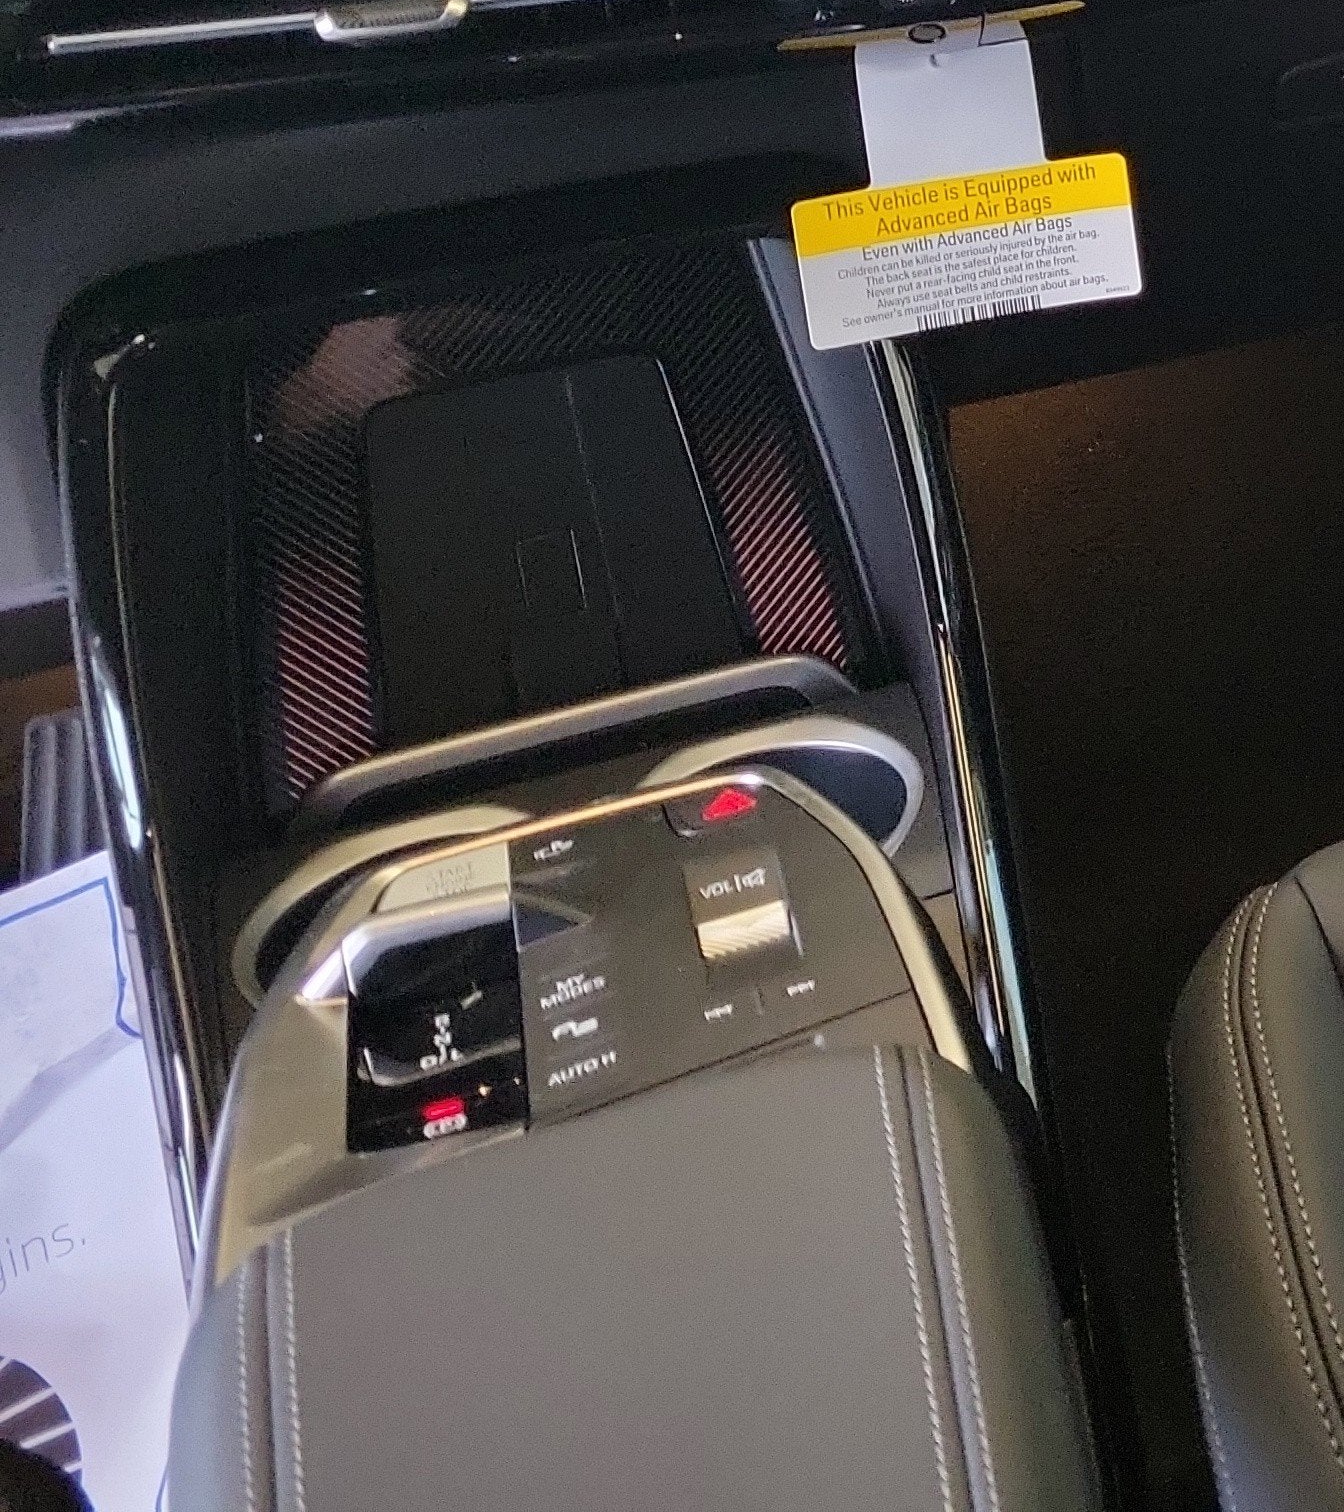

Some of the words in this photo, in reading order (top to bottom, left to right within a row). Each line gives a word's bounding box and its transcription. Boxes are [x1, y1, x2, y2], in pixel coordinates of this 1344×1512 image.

[822, 200, 864, 221] This
[868, 186, 939, 212] Vehicle
[944, 183, 959, 201] is
[964, 168, 1053, 200] Equipped
[1057, 163, 1096, 183] with
[877, 204, 969, 236] Advanced
[975, 200, 1000, 225] Air
[1005, 195, 1052, 216] Bags
[838, 265, 880, 280] Children
[881, 262, 900, 272] can
[901, 257, 915, 268] be
[915, 252, 941, 266] killed
[943, 251, 954, 261] or
[955, 243, 999, 259] seriously
[1000, 238, 1032, 252] injured
[1034, 235, 1046, 248] by
[1047, 233, 1063, 244] the
[1065, 231, 1078, 241] air
[1079, 229, 1100, 240] bag.
[862, 244, 899, 262] Even
[902, 237, 933, 255] with
[937, 222, 1009, 248] Advanced
[1012, 219, 1032, 236] Air
[1035, 216, 1072, 233] Bags
[866, 275, 885, 287] The
[886, 270, 910, 283] back
[911, 267, 932, 278] seat
[934, 264, 942, 275] is
[944, 261, 960, 272] the
[962, 256, 991, 269] safest
[993, 251, 1019, 266] place
[1021, 248, 1035, 259] for
[1036, 244, 1076, 257] children.
[866, 286, 895, 299] Never
[897, 282, 913, 294] put
[915, 280, 922, 289] a
[923, 272, 977, 288] rear-facing
[978, 265, 1003, 278] child
[1004, 262, 1023, 273] seat
[1025, 260, 1034, 270] in
[1036, 258, 1051, 268] the
[1053, 254, 1079, 266] front.
[842, 317, 862, 328] See
[864, 308, 902, 323] owner's
[904, 301, 940, 316] manual
[941, 299, 955, 309] for
[957, 293, 982, 306] more
[984, 283, 1039, 300] information
[1041, 278, 1067, 291] about
[1069, 276, 1081, 286] air
[1082, 273, 1109, 285] bags.
[877, 296, 911, 309] Always
[913, 292, 930, 302] use
[932, 288, 952, 299] seat
[954, 282, 978, 294] belts
[980, 278, 998, 289] and
[1000, 273, 1023, 285] child
[1025, 268, 1071, 281] restraints.
[700, 879, 734, 899] VOL
[548, 1057, 599, 1086] AUTO
[601, 1050, 617, 1067] H
